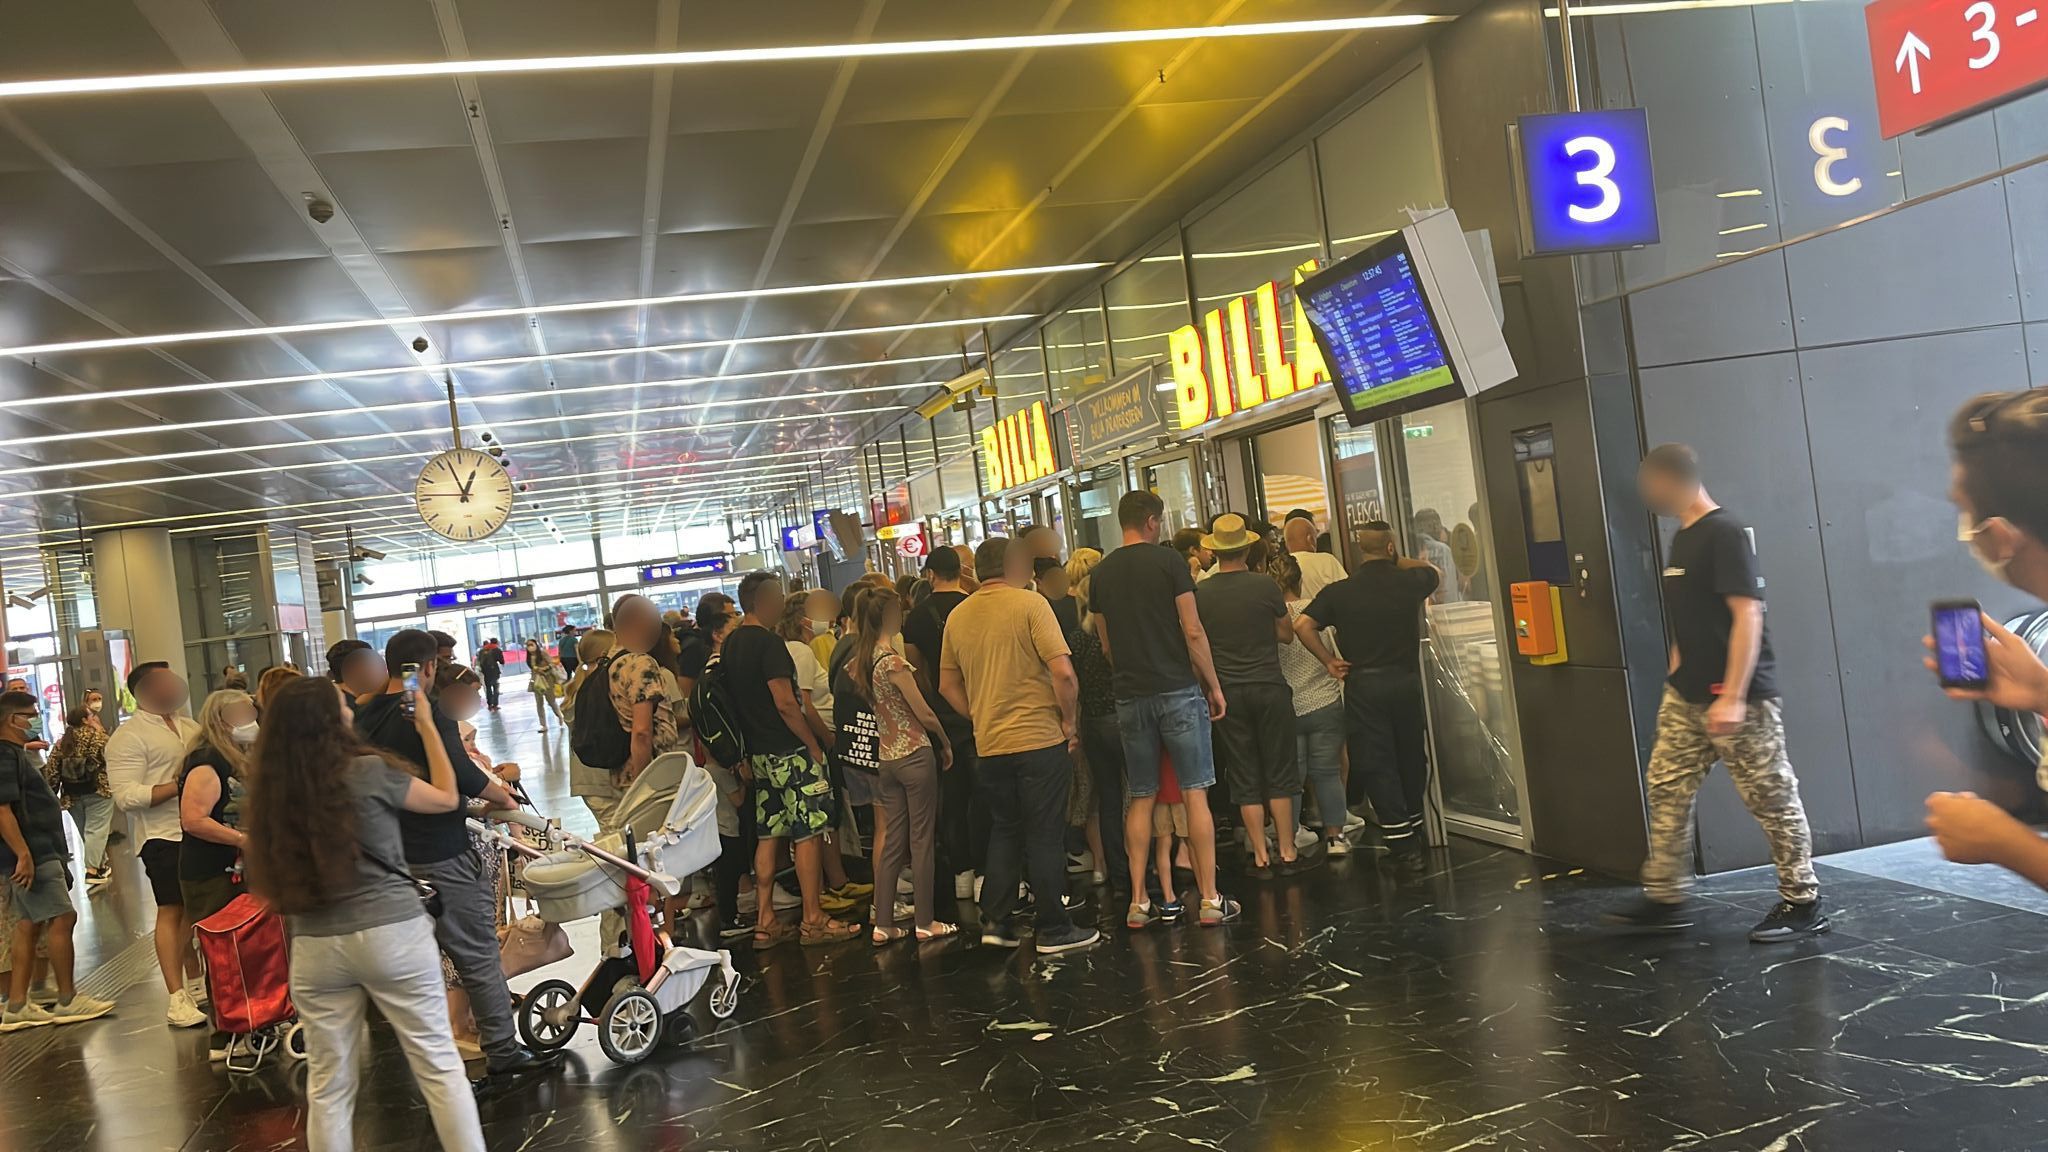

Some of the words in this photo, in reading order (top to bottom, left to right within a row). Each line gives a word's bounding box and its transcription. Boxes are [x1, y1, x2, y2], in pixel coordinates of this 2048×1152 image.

[1964, 1, 2000, 69] 3
[1565, 136, 1621, 222] 3
[982, 400, 1056, 493] BILLA
[1346, 500, 1381, 528] FLEISCH
[857, 719, 876, 728] THE
[843, 724, 880, 737] STUDEN
[857, 735, 870, 743] IN
[852, 742, 872, 751] YOU
[848, 749, 872, 759] LIVE
